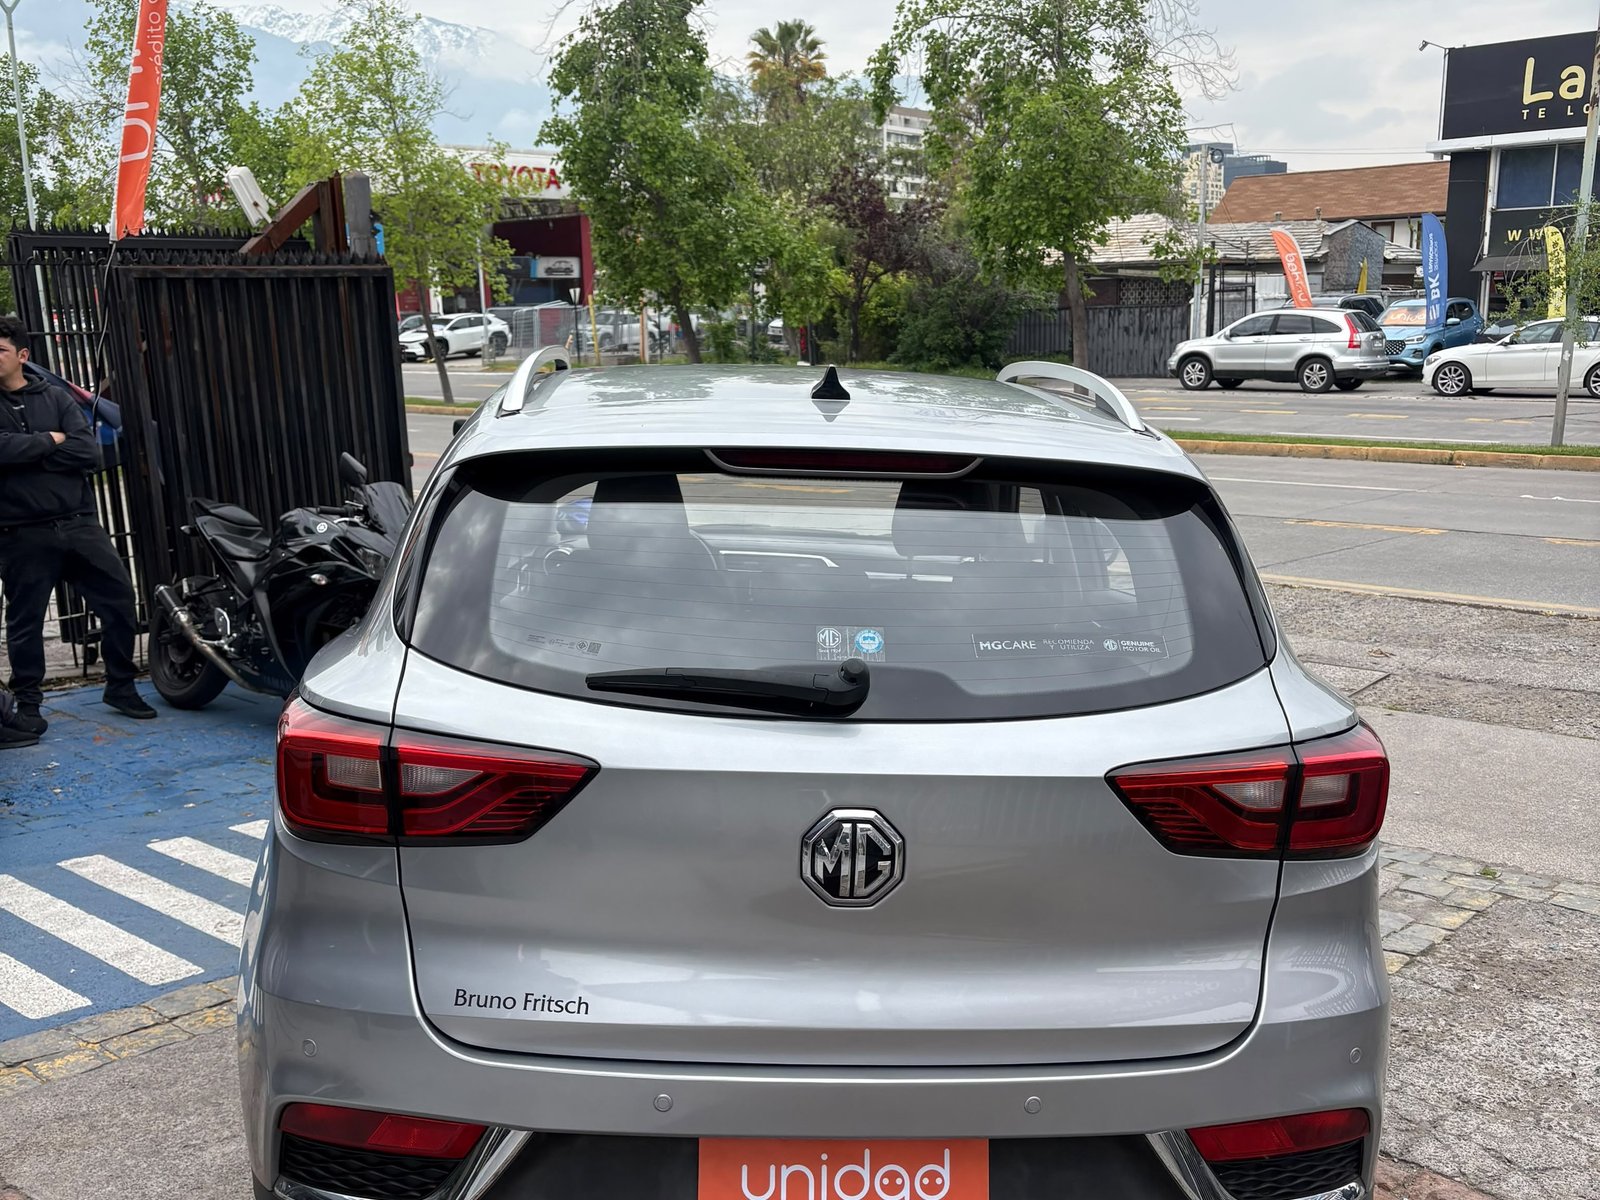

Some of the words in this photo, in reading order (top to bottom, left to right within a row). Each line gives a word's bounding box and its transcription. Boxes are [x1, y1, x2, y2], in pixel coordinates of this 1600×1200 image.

[1521, 107, 1546, 120] TE
[1427, 273, 1441, 301] BK
[819, 629, 840, 647] MG
[979, 640, 1037, 650] MGCARE
[814, 822, 892, 897] MG
[453, 988, 517, 1010] Bruno
[522, 992, 589, 1015] Fritsch
[741, 1147, 951, 1200] unidad
